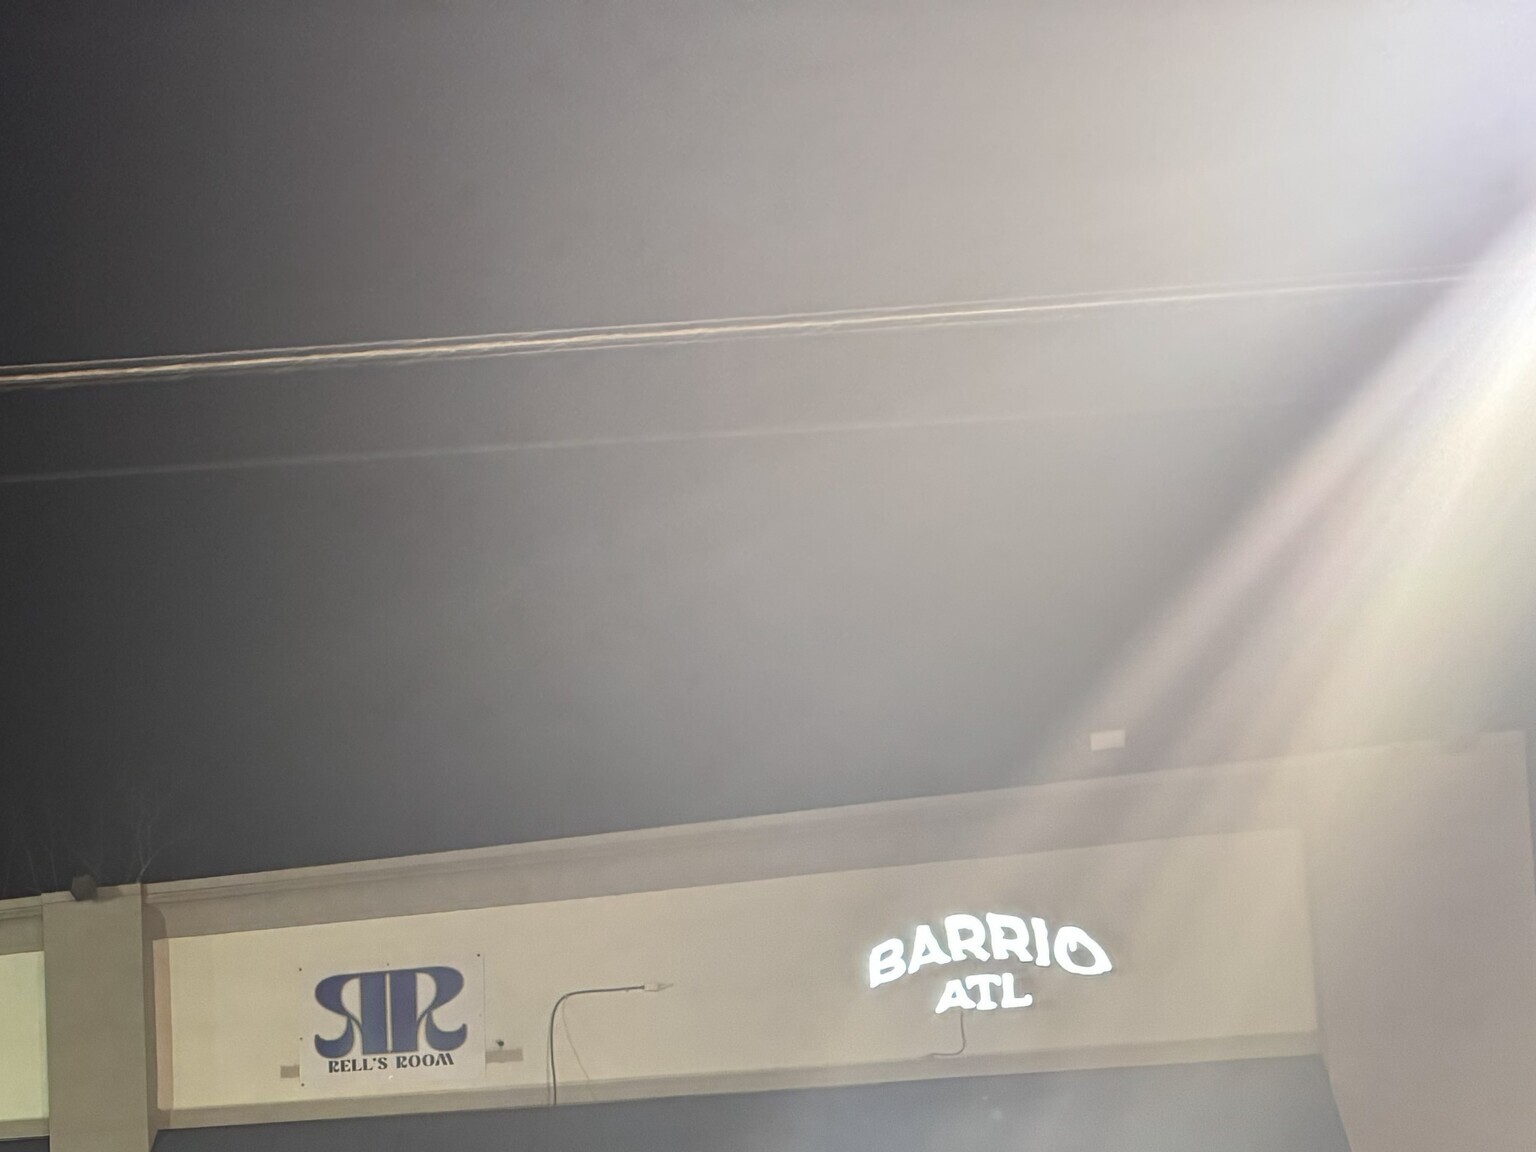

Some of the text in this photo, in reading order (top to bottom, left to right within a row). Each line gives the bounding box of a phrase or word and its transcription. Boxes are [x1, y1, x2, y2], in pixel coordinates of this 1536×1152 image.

[869, 912, 1112, 988] BARRIO
[935, 972, 1032, 1014] ATL
[328, 1053, 454, 1073] RELL'S ROOM
